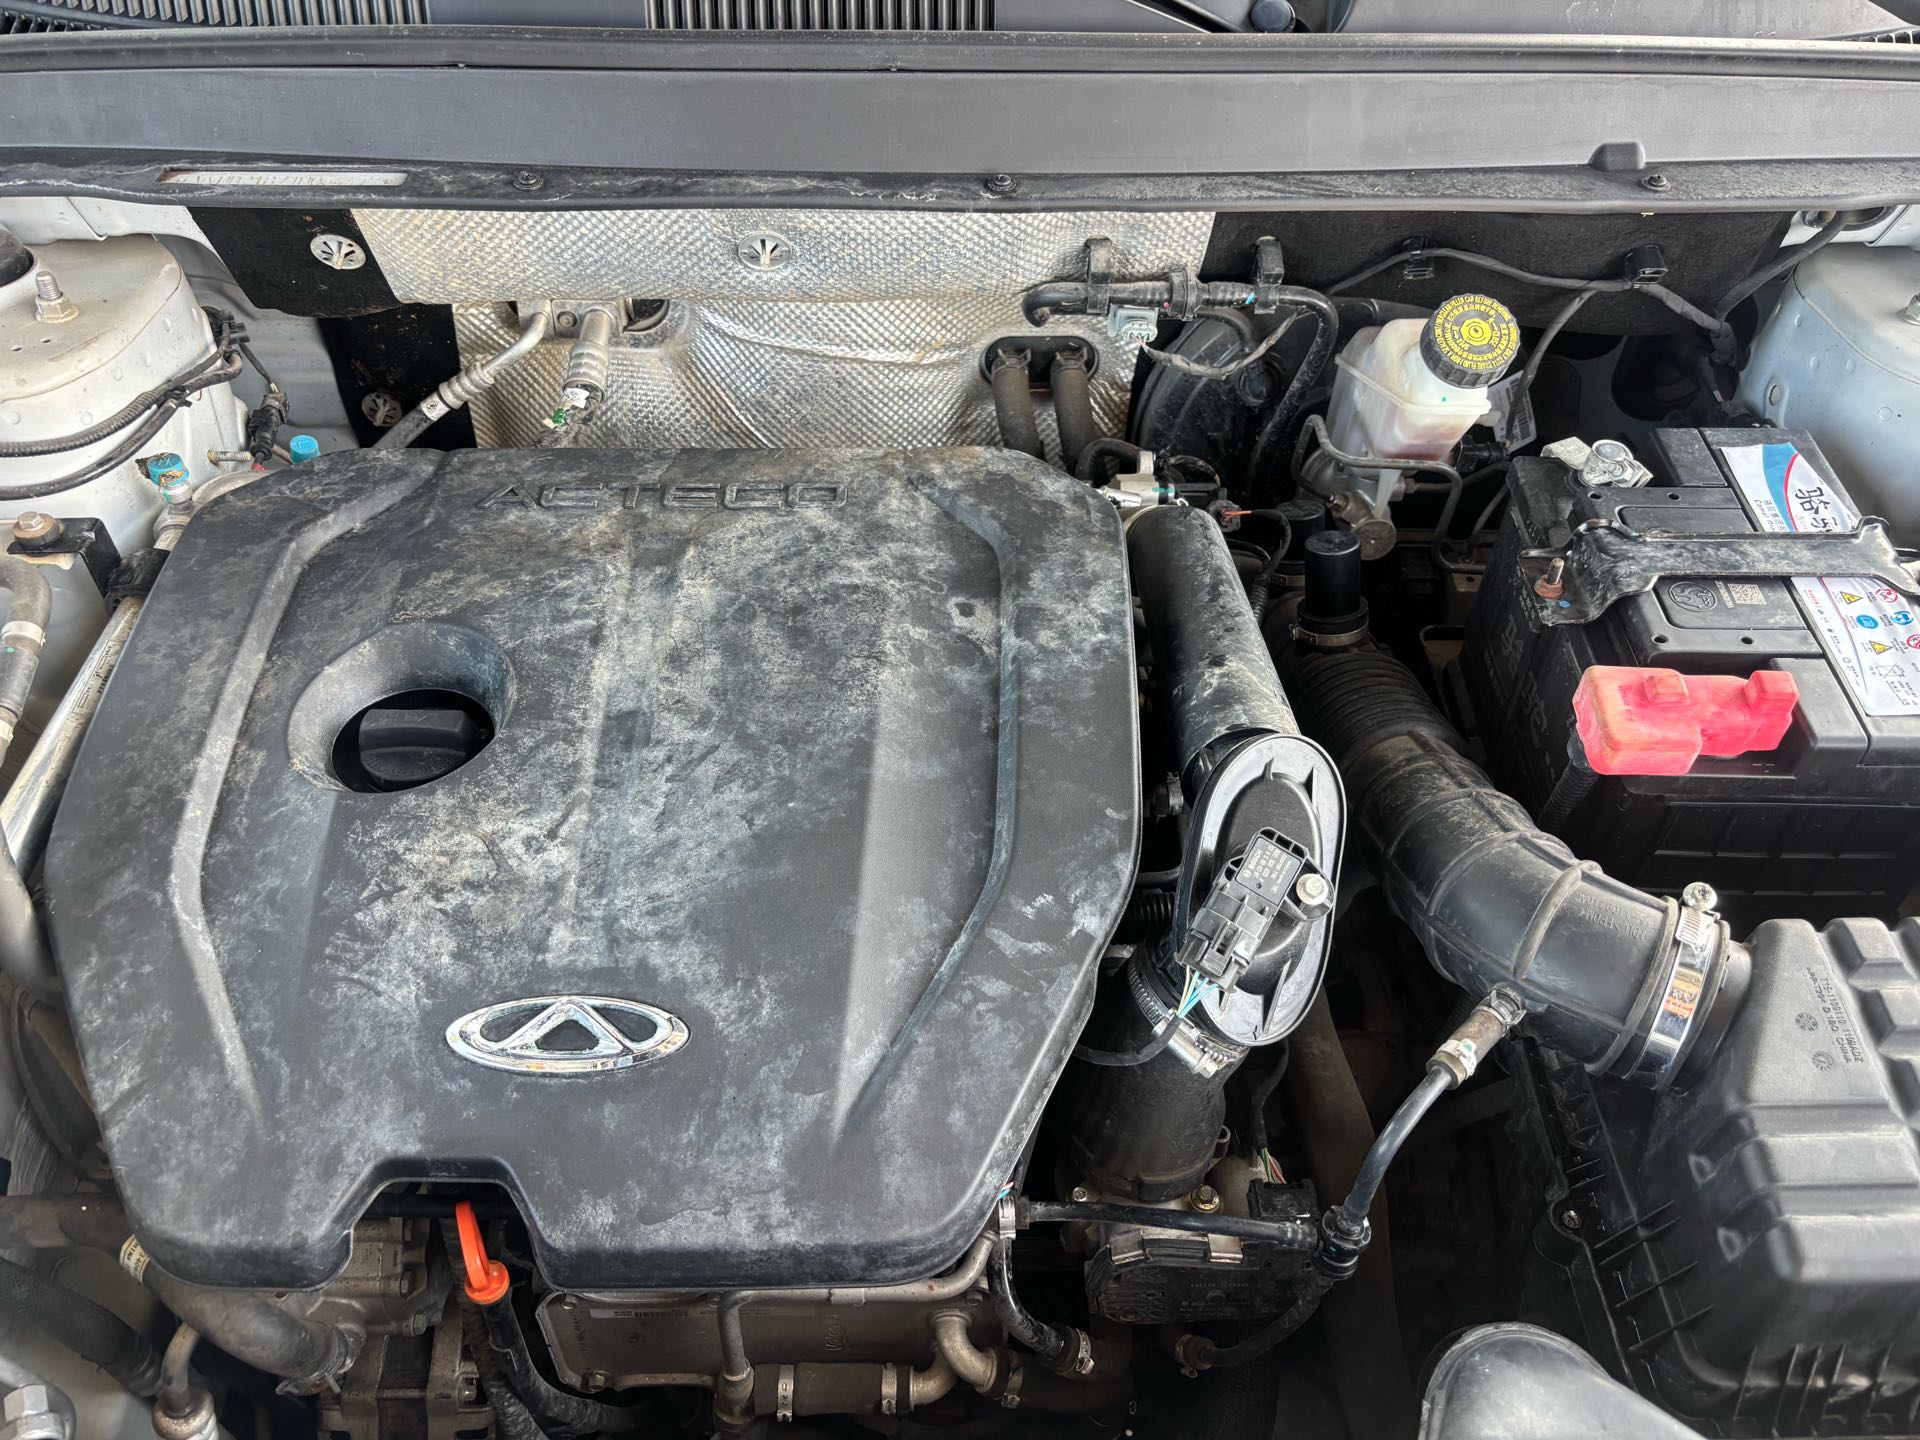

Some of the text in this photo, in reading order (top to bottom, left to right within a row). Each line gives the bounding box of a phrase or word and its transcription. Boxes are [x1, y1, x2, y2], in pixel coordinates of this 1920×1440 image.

[477, 481, 849, 510] ACTECO
[1248, 849, 1262, 869] BOSCH
[1836, 1036, 1850, 1063] CHINA
